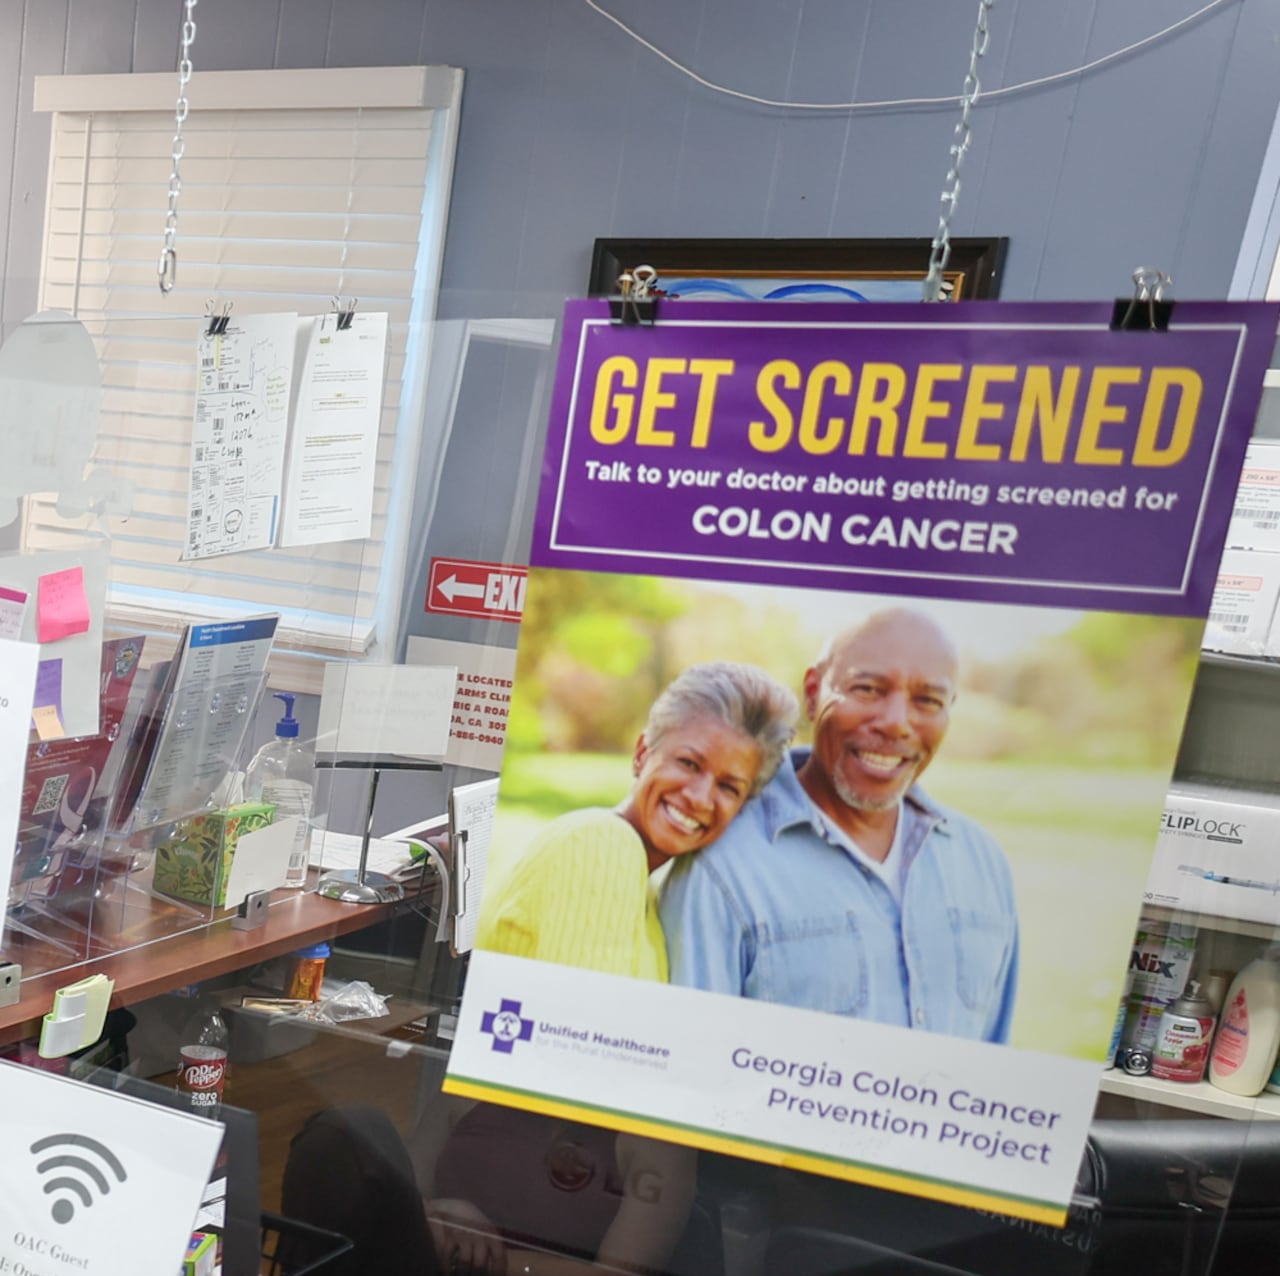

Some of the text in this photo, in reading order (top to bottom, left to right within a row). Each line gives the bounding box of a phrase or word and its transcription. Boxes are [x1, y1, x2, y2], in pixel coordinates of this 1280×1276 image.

[589, 355, 1203, 467] GET SCREENED
[585, 459, 1178, 512] Talk to your doctor about getting screened for
[692, 504, 1018, 555] COLON CANCER
[484, 573, 528, 612] EXI
[457, 687, 512, 702] ARMS CLIN
[458, 673, 513, 688] E LOCATED
[453, 701, 471, 711] BIG
[473, 703, 481, 712] A
[468, 717, 483, 727] GA
[488, 720, 507, 731] 305
[1130, 951, 1175, 979] Nix
[539, 1021, 670, 1058] Unified Healthcare
[188, 1066, 222, 1086] Pepper
[200, 1064, 214, 1074] Dr
[191, 1091, 218, 1101] zero
[731, 1047, 1062, 1130] Georgia Colon Cancer
[767, 1087, 1053, 1165] Prevention Project
[13, 1231, 90, 1270] OAC Guest
